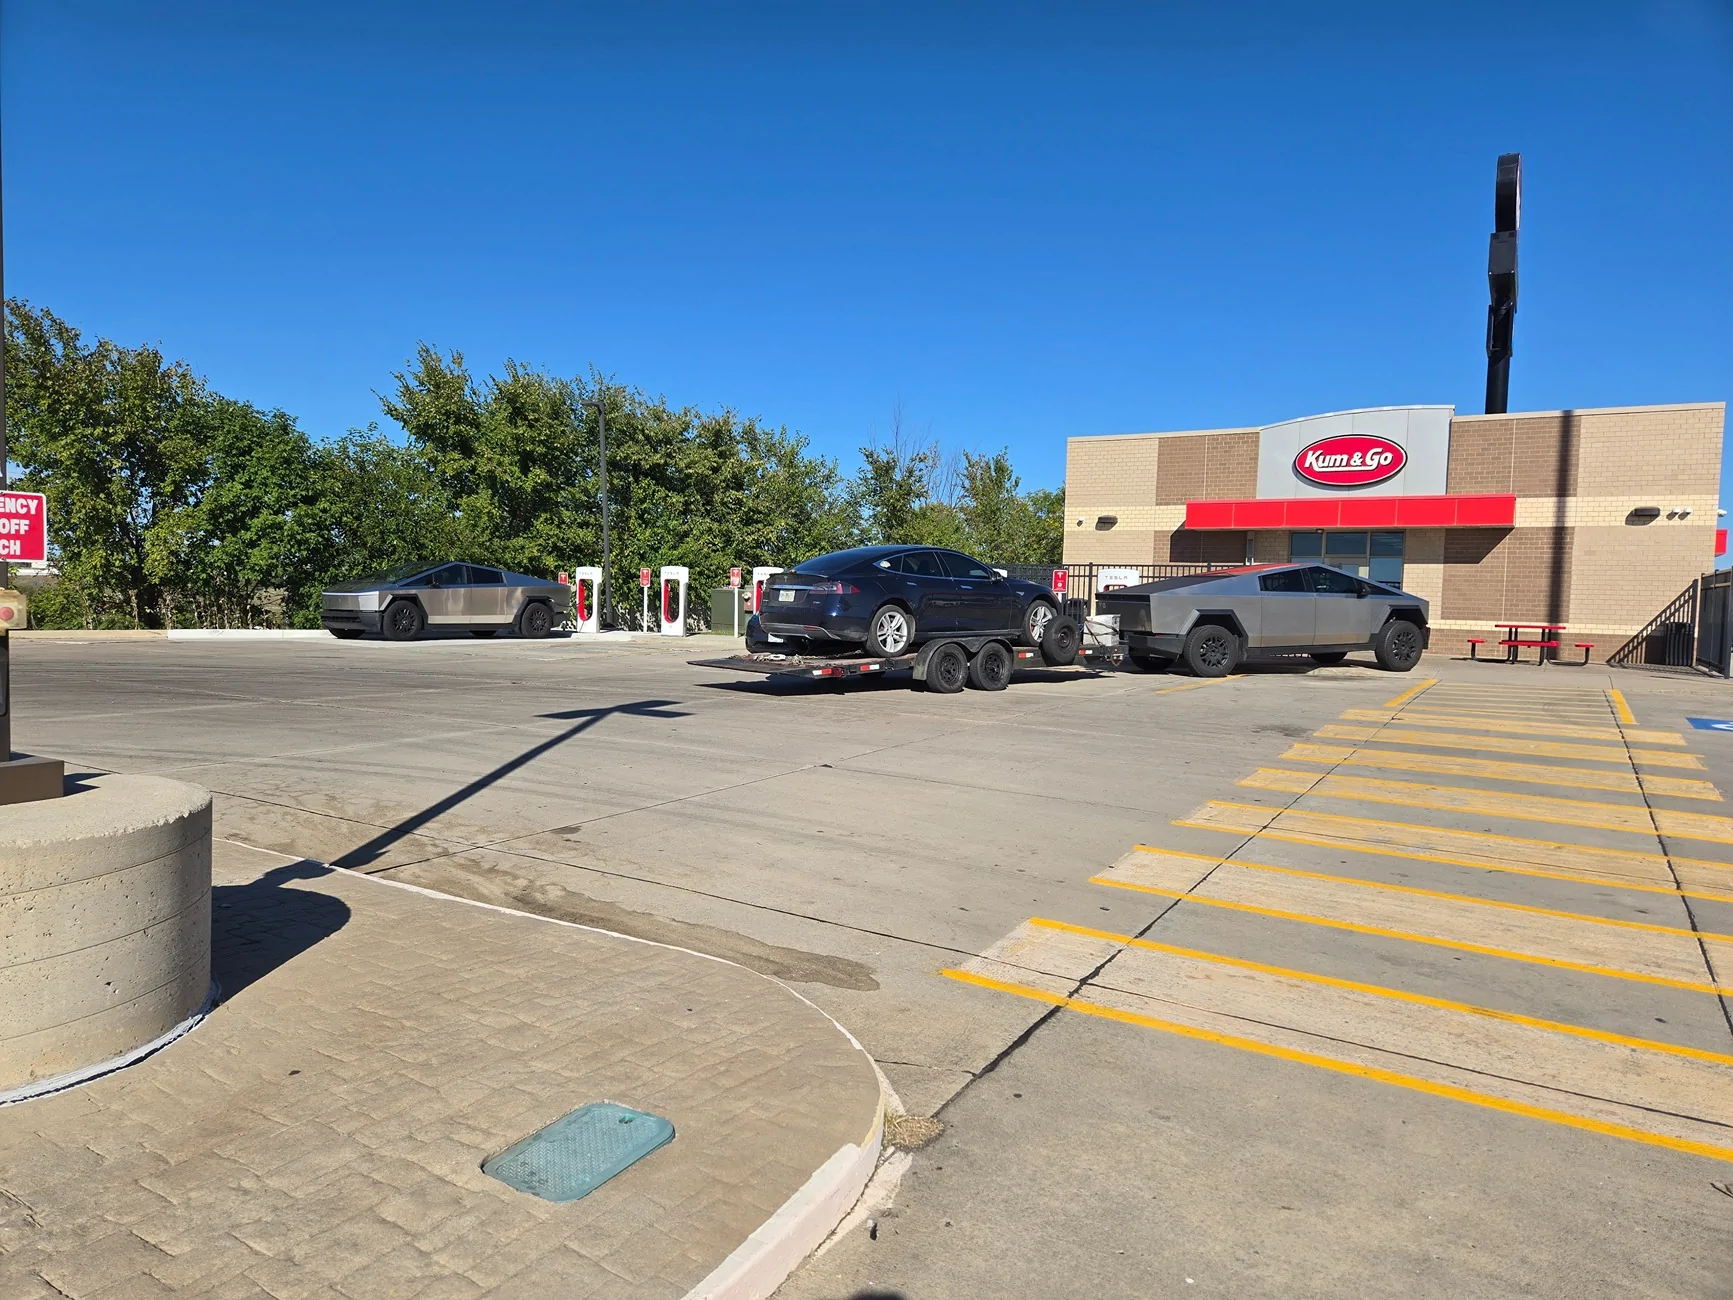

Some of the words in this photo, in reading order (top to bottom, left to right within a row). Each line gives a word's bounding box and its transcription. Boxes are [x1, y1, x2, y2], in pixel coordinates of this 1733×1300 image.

[1304, 450, 1349, 470] Kum
[1350, 452, 1363, 466] &
[1365, 448, 1393, 469] Go
[0, 518, 30, 534] OFF
